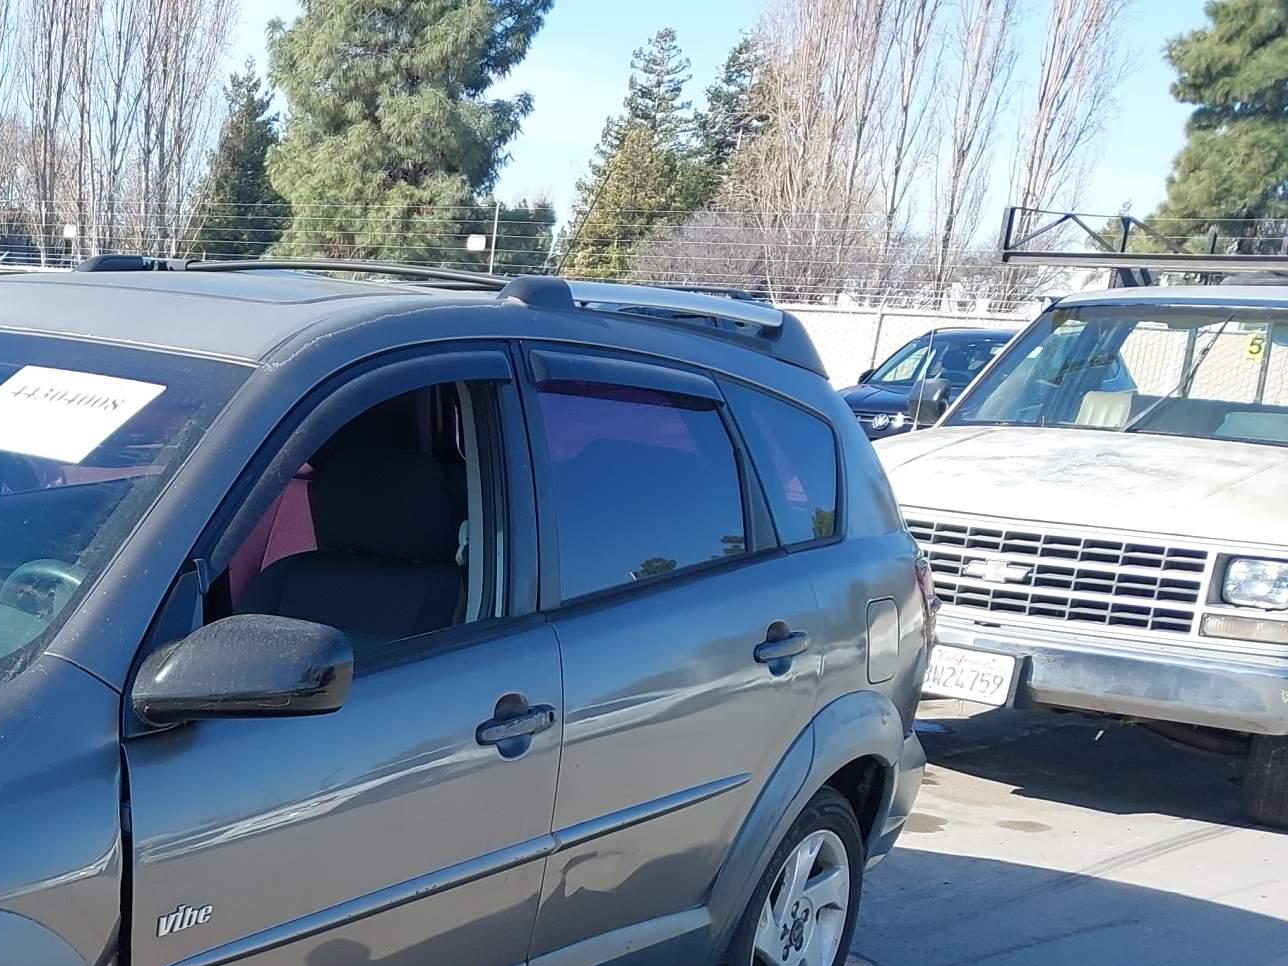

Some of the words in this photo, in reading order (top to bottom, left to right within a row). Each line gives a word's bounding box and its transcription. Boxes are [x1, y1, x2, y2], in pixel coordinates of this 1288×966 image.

[1248, 337, 1265, 355] 5
[11, 386, 124, 410] 44304008
[156, 904, 213, 938] vibe
